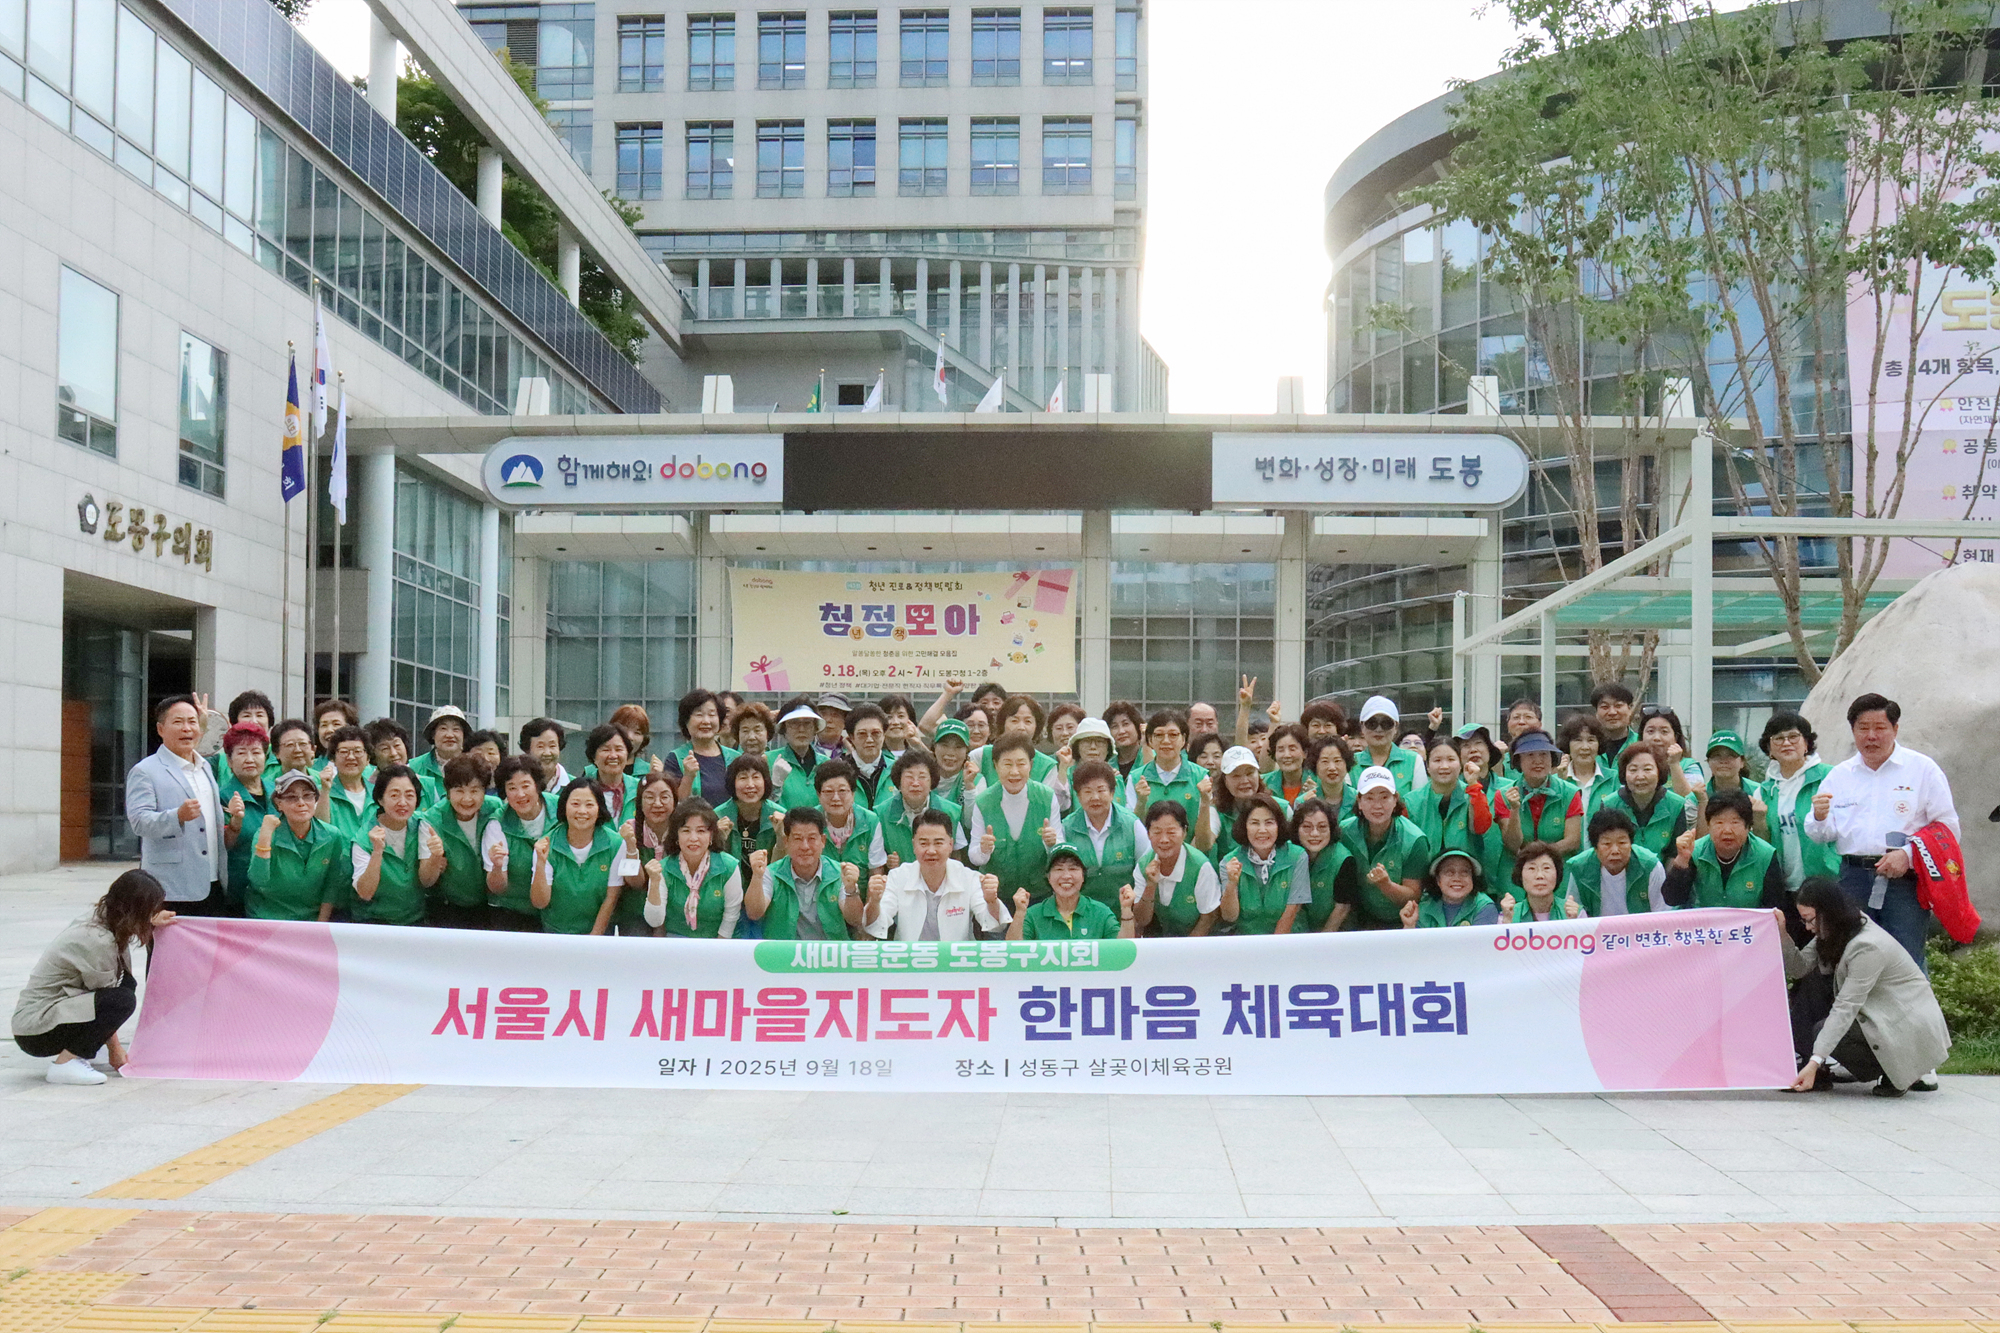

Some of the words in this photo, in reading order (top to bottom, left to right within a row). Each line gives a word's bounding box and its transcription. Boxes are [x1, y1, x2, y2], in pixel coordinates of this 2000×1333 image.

[1941, 291, 2000, 332] 도
[1885, 360, 1903, 377] 총
[1918, 358, 1951, 375] 4개
[557, 454, 652, 486] 함께해요!
[660, 454, 767, 484] dobong
[1428, 454, 1483, 488] 도봉
[104, 501, 213, 573] 도봉구의회
[869, 580, 886, 592] 청년
[872, 669, 886, 677] 오후
[938, 669, 966, 677] 도봉구청
[1494, 929, 1595, 955] dobong
[1601, 934, 1629, 950] 같이
[1635, 931, 1672, 948] 변화,
[1674, 929, 1723, 945] 행복한
[1727, 925, 1754, 945] 도봉
[790, 941, 939, 969] 새마을운동
[949, 941, 1099, 968] 도봉구지회
[431, 987, 608, 1041] 서울시
[629, 987, 998, 1042] 새마을지도자
[1018, 985, 1200, 1041] 한마음
[1222, 980, 1469, 1039] 체육대회
[657, 1058, 697, 1076] 일자
[720, 1058, 797, 1077] 2025년
[805, 1058, 840, 1077] 9월
[848, 1058, 893, 1077] 18일
[954, 1059, 995, 1078] 장소
[1019, 1058, 1080, 1077] 성동구
[1088, 1056, 1233, 1077] 살곶이체육공원
